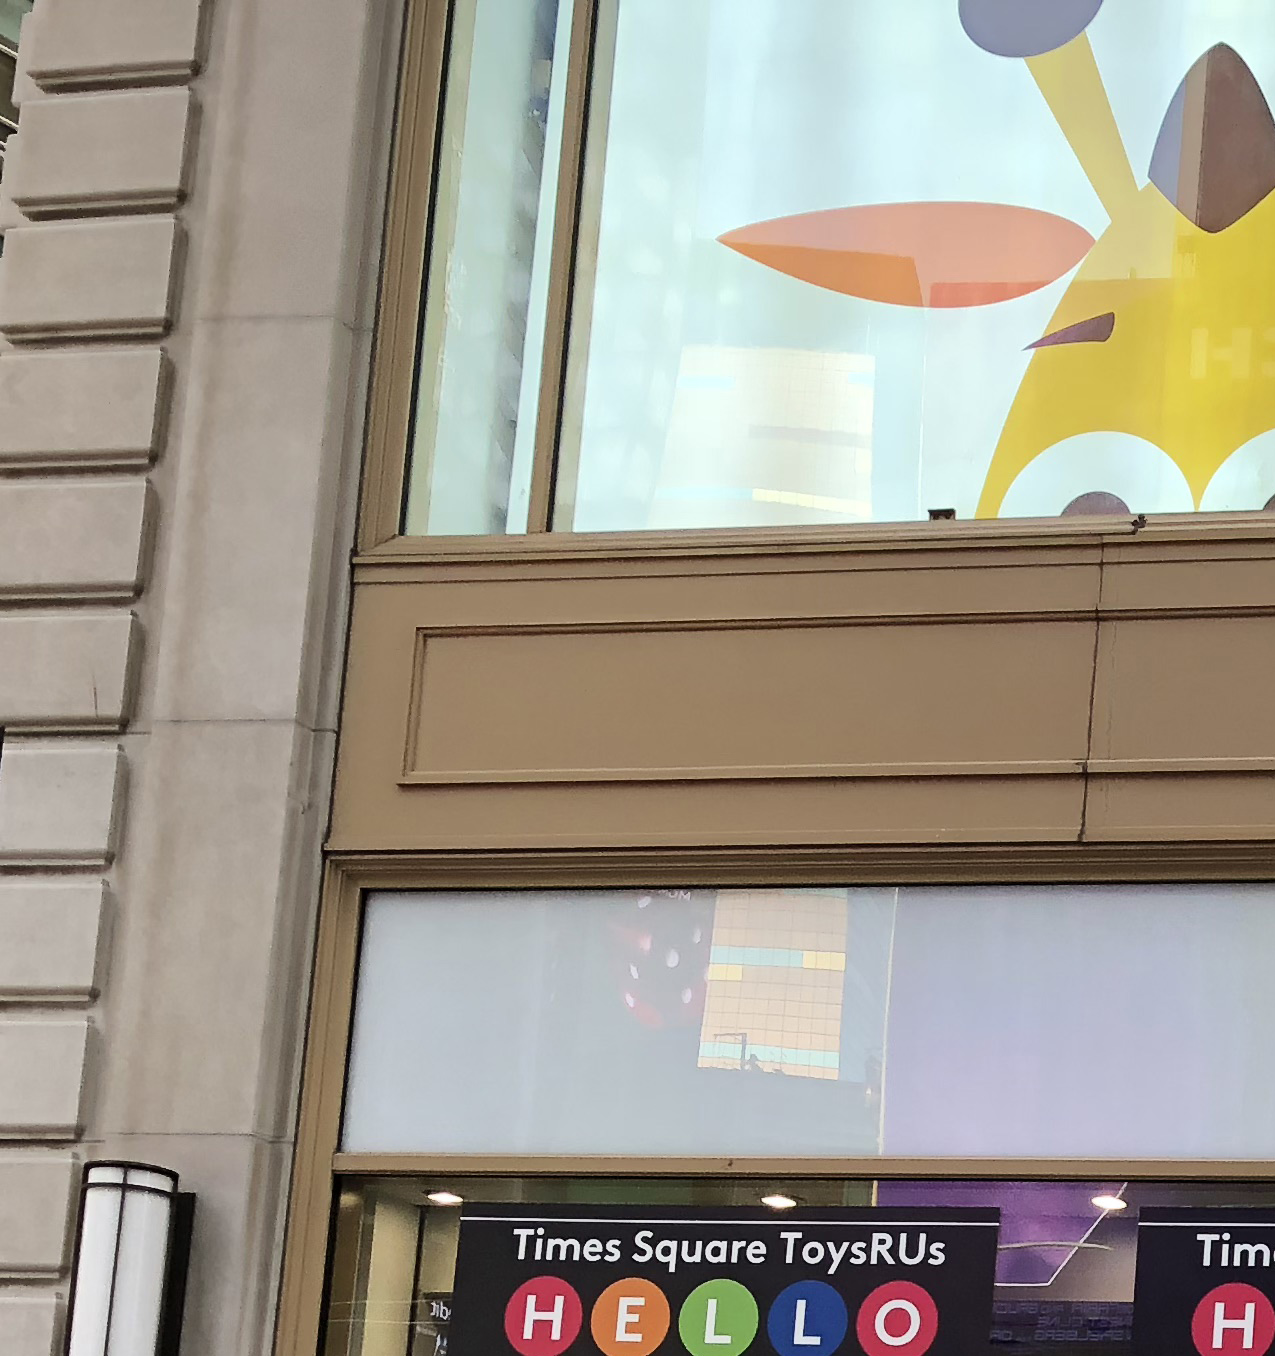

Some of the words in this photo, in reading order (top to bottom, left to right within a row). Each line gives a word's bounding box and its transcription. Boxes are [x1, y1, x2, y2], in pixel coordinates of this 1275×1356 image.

[513, 1228, 620, 1264] Times
[632, 1231, 767, 1272] Square
[780, 1232, 946, 1275] ToysRUs
[523, 1295, 919, 1346] HELLO
